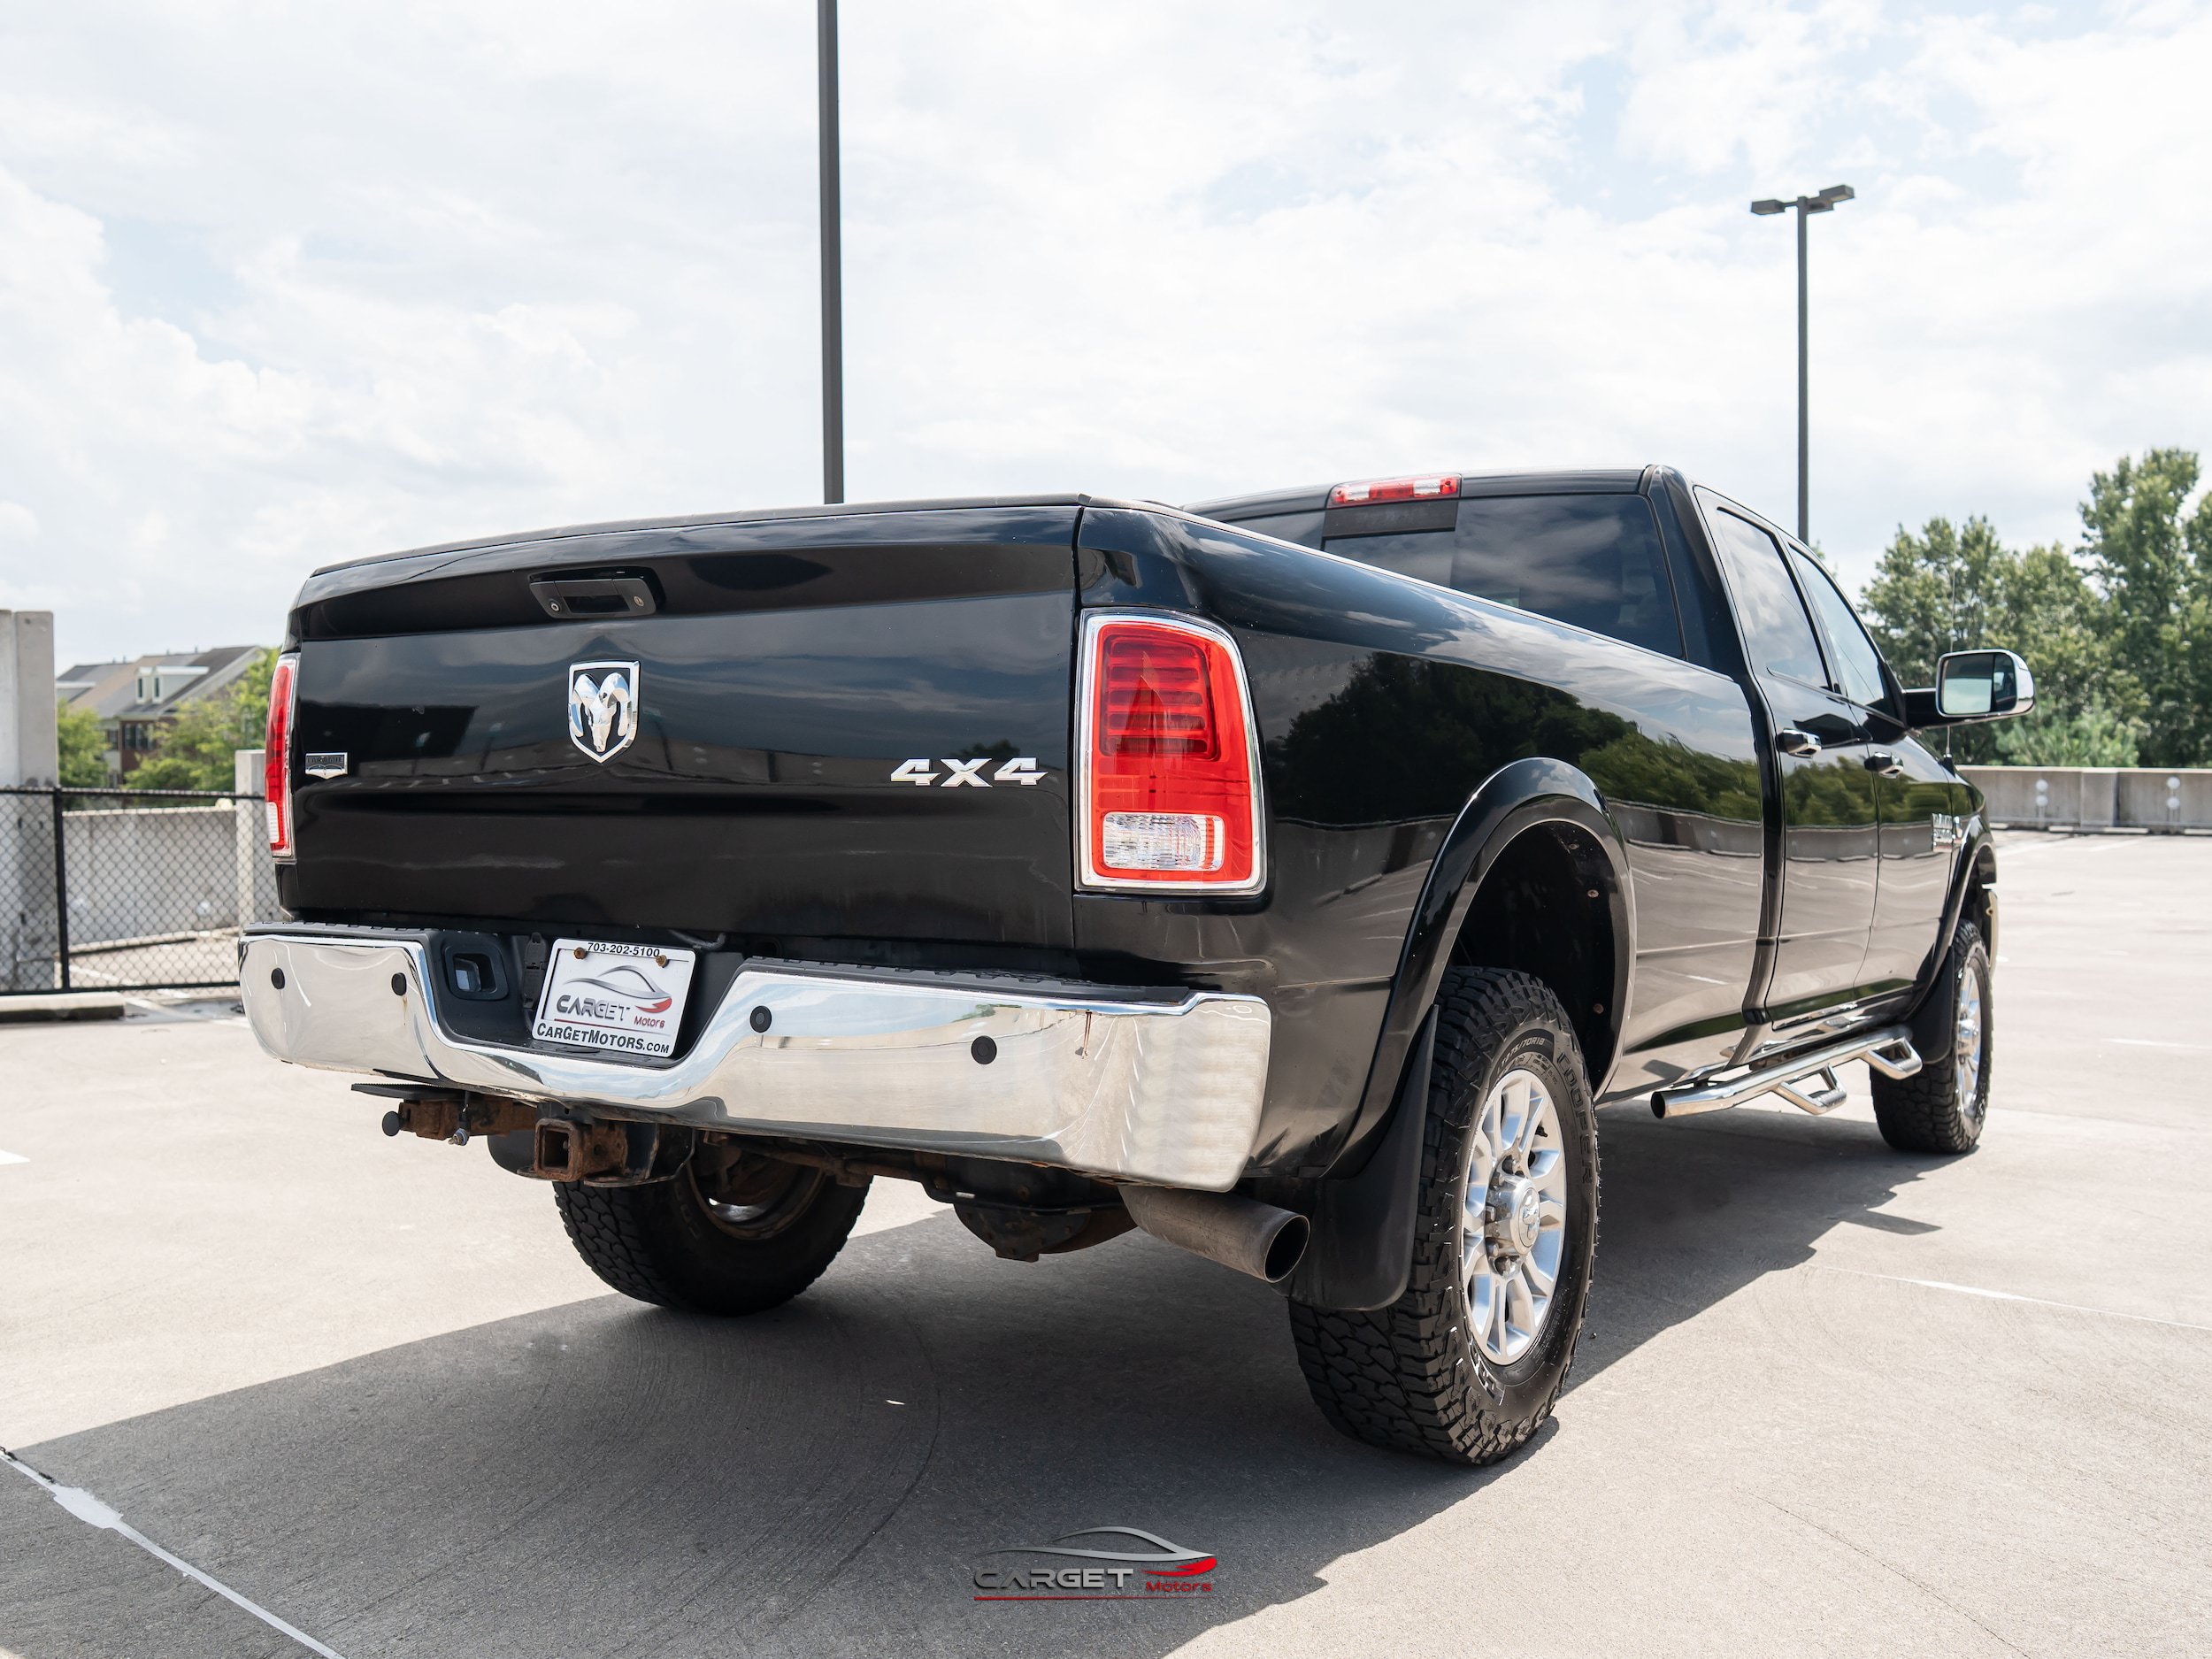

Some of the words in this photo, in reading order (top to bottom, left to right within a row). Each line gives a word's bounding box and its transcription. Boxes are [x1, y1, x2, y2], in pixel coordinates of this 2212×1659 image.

[587, 942, 660, 958] 703-202-5100
[557, 995, 631, 1021] CARGET
[634, 1015, 665, 1028] Motors
